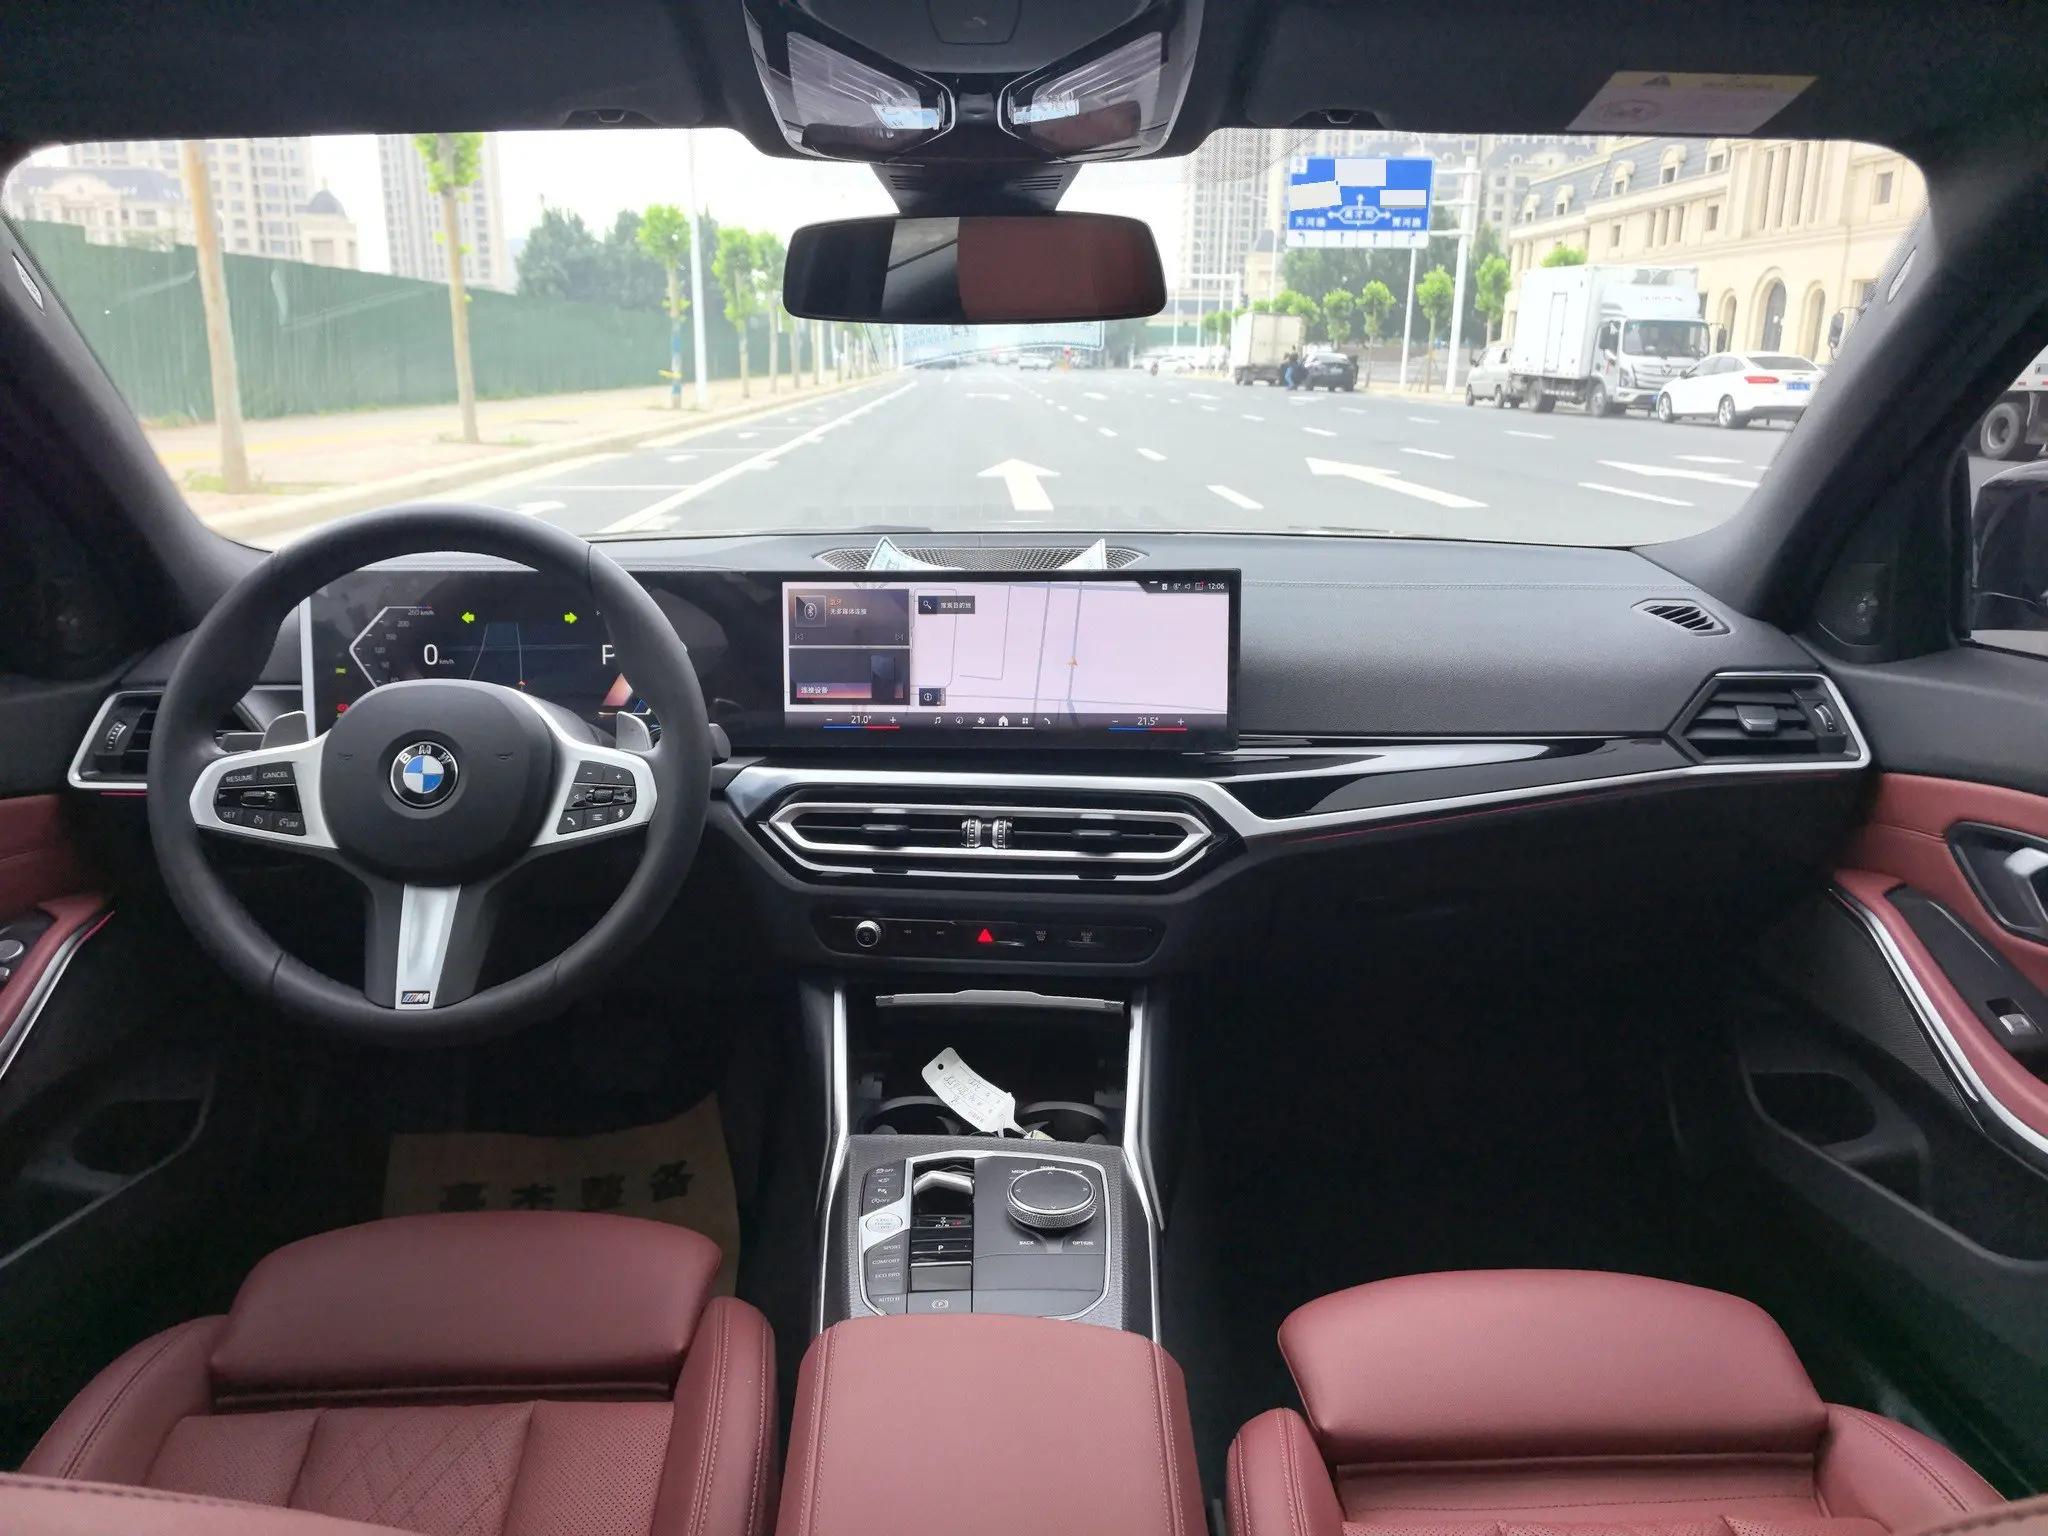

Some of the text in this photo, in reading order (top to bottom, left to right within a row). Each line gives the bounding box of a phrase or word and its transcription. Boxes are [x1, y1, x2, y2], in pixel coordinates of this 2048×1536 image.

[1208, 582, 1225, 590] 12:06
[424, 644, 438, 665] 0
[399, 744, 452, 765] BMW
[225, 774, 253, 783] RESUME
[262, 771, 289, 779] CANCEL
[224, 811, 236, 819] SET
